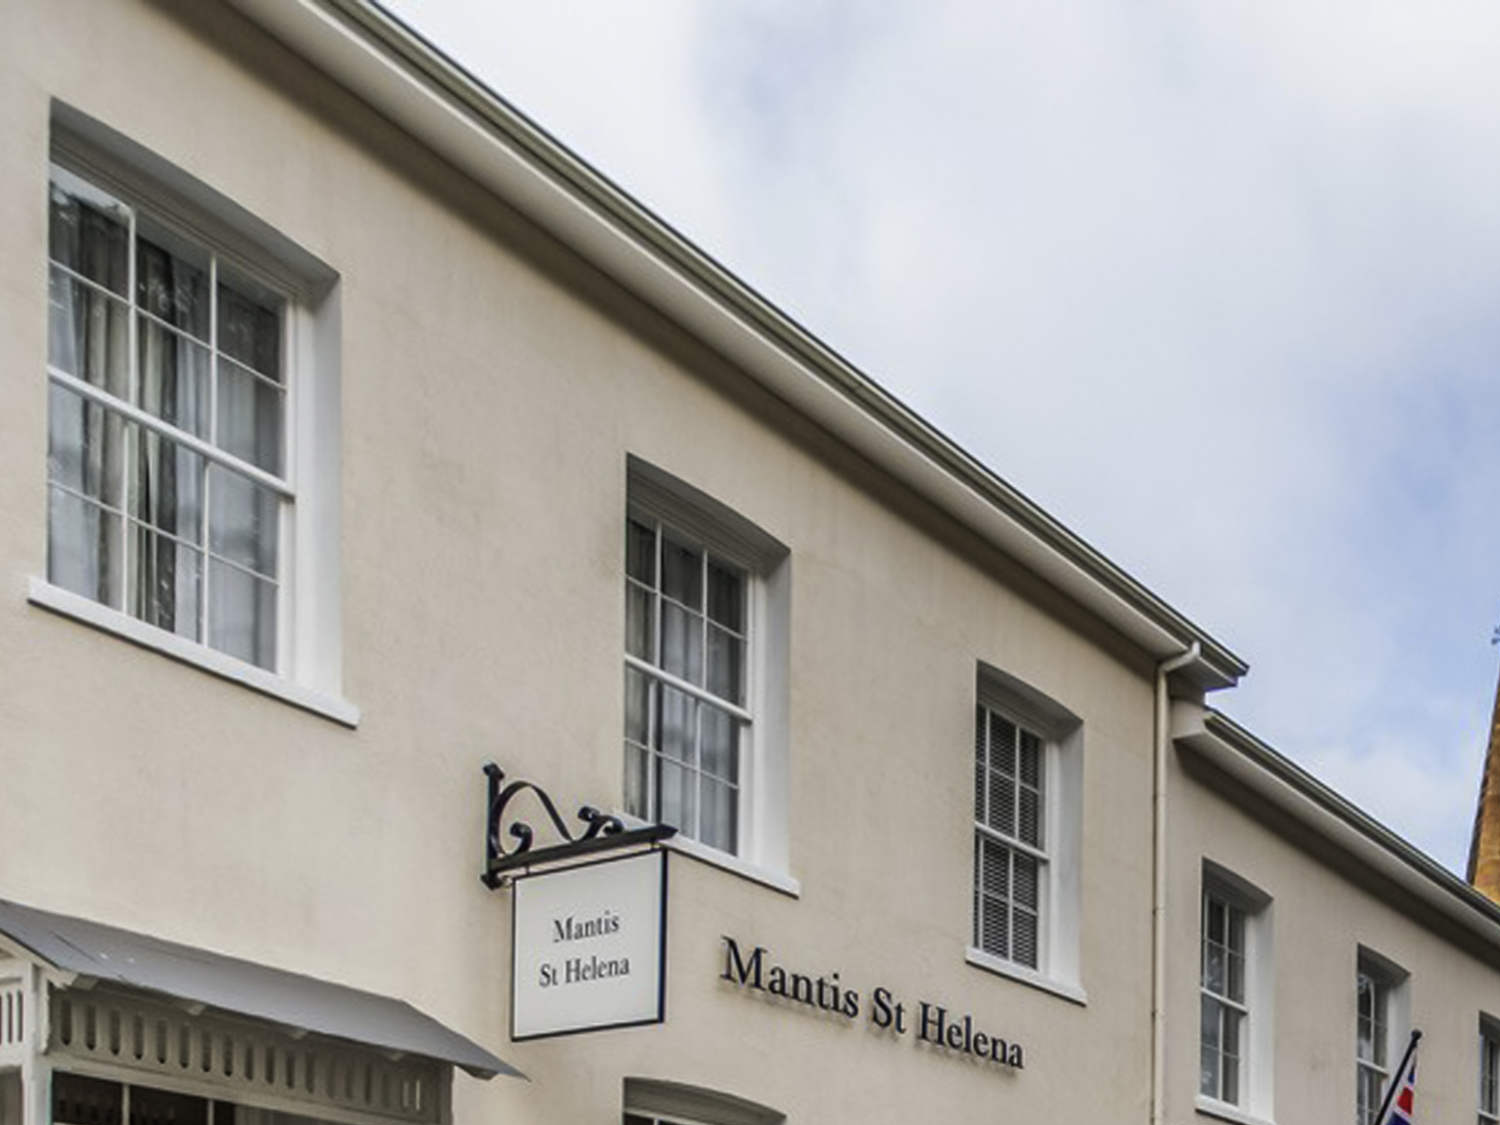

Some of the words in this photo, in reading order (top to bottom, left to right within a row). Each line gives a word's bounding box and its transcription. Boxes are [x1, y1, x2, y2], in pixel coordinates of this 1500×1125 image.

[552, 911, 620, 943] Mantis
[538, 963, 559, 988] St
[565, 956, 630, 984] Helena
[720, 935, 860, 1018] Mantis
[872, 987, 906, 1034] St
[920, 1002, 1025, 1070] Helena
